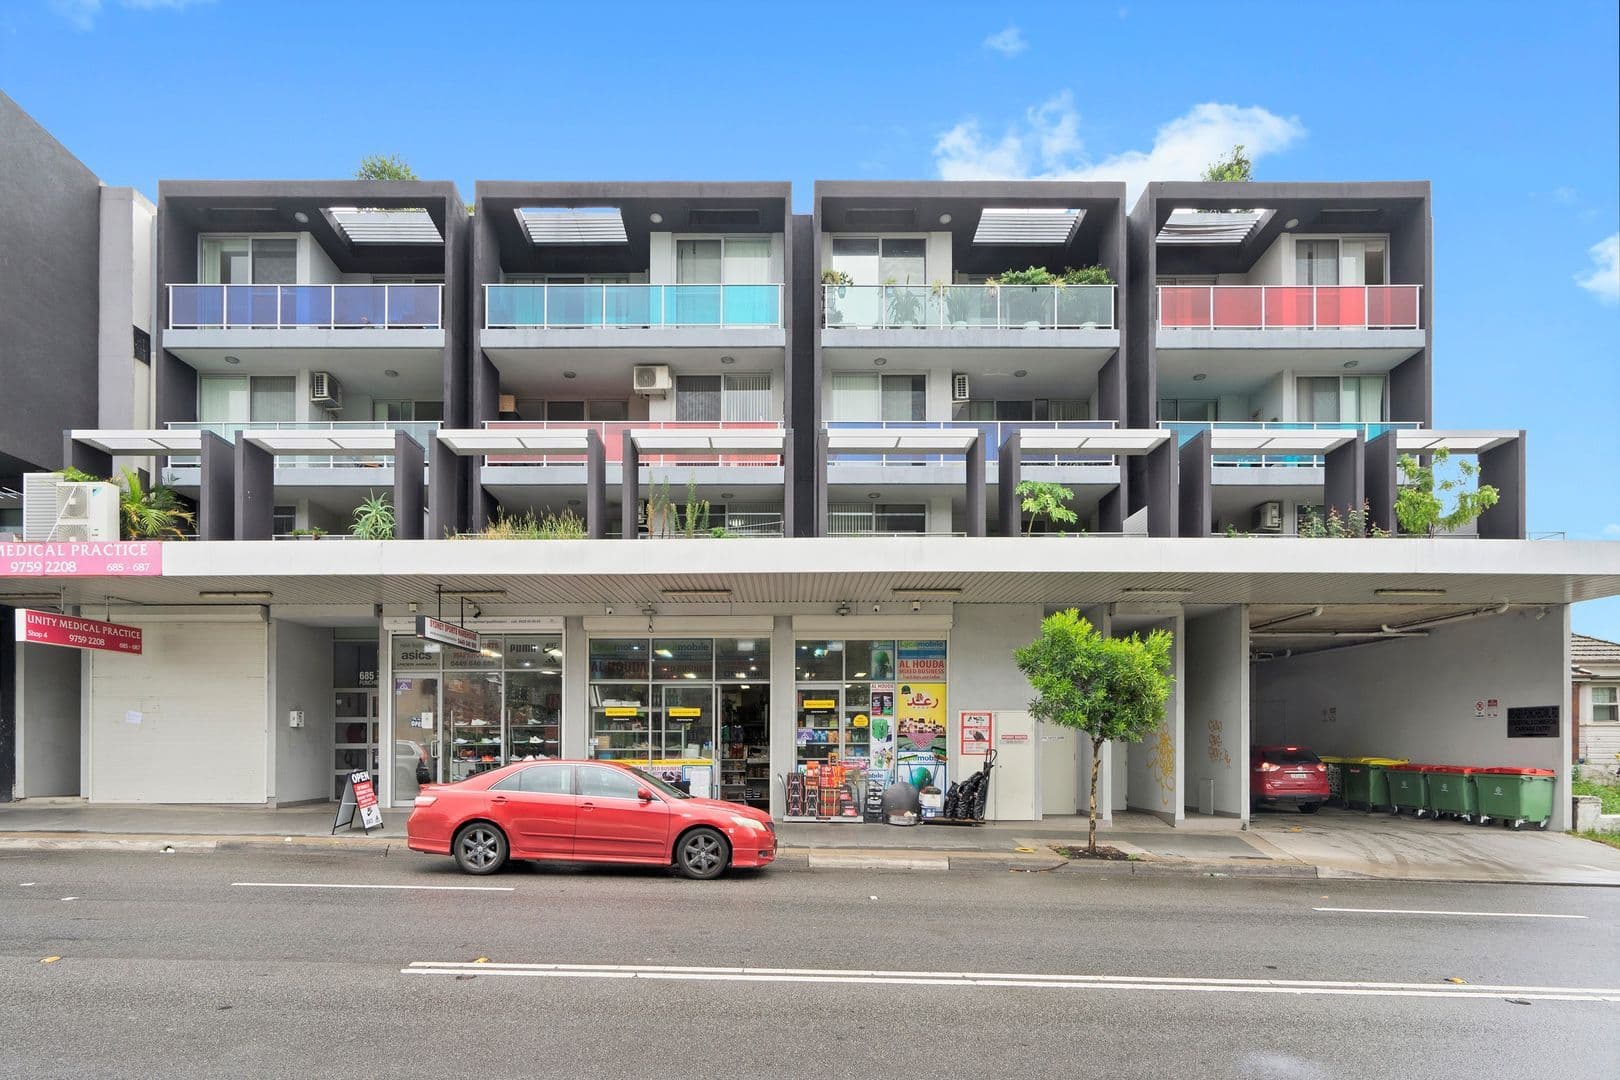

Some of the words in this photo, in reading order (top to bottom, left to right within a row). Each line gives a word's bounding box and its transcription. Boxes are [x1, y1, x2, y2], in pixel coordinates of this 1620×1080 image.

[71, 543, 149, 557] PRACTICE
[10, 561, 42, 573] 9759
[44, 561, 77, 573] 2208
[106, 562, 124, 572] 685
[132, 562, 151, 572] 687
[27, 614, 57, 626] UNITY
[59, 619, 101, 634] MEDICAL
[102, 626, 141, 640] PRACTICE
[27, 630, 43, 639] Shop
[68, 634, 87, 644] 9759
[87, 635, 106, 646] 2208
[400, 649, 432, 660] asics
[899, 659, 911, 668] AL
[912, 659, 945, 668] HOUDA
[359, 671, 375, 680] 685
[411, 720, 423, 728] OPE
[352, 771, 370, 783] OPEN
